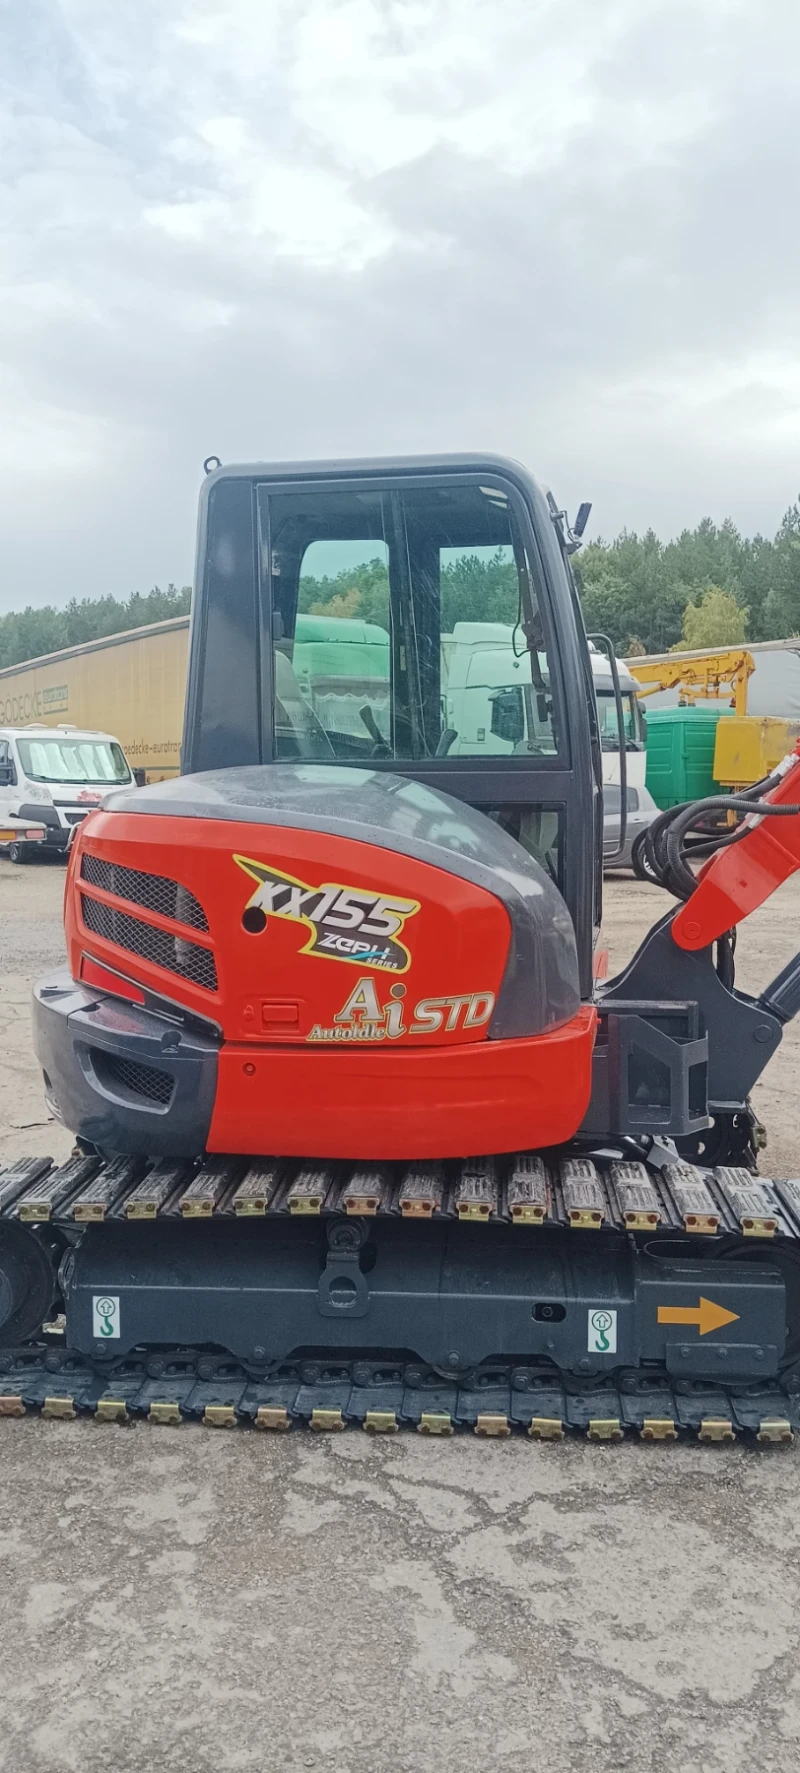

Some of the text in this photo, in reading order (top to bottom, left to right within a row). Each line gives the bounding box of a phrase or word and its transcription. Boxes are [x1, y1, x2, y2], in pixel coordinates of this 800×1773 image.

[250, 881, 417, 937] KX155
[366, 957, 398, 969] SERIES
[409, 991, 495, 1034] STD
